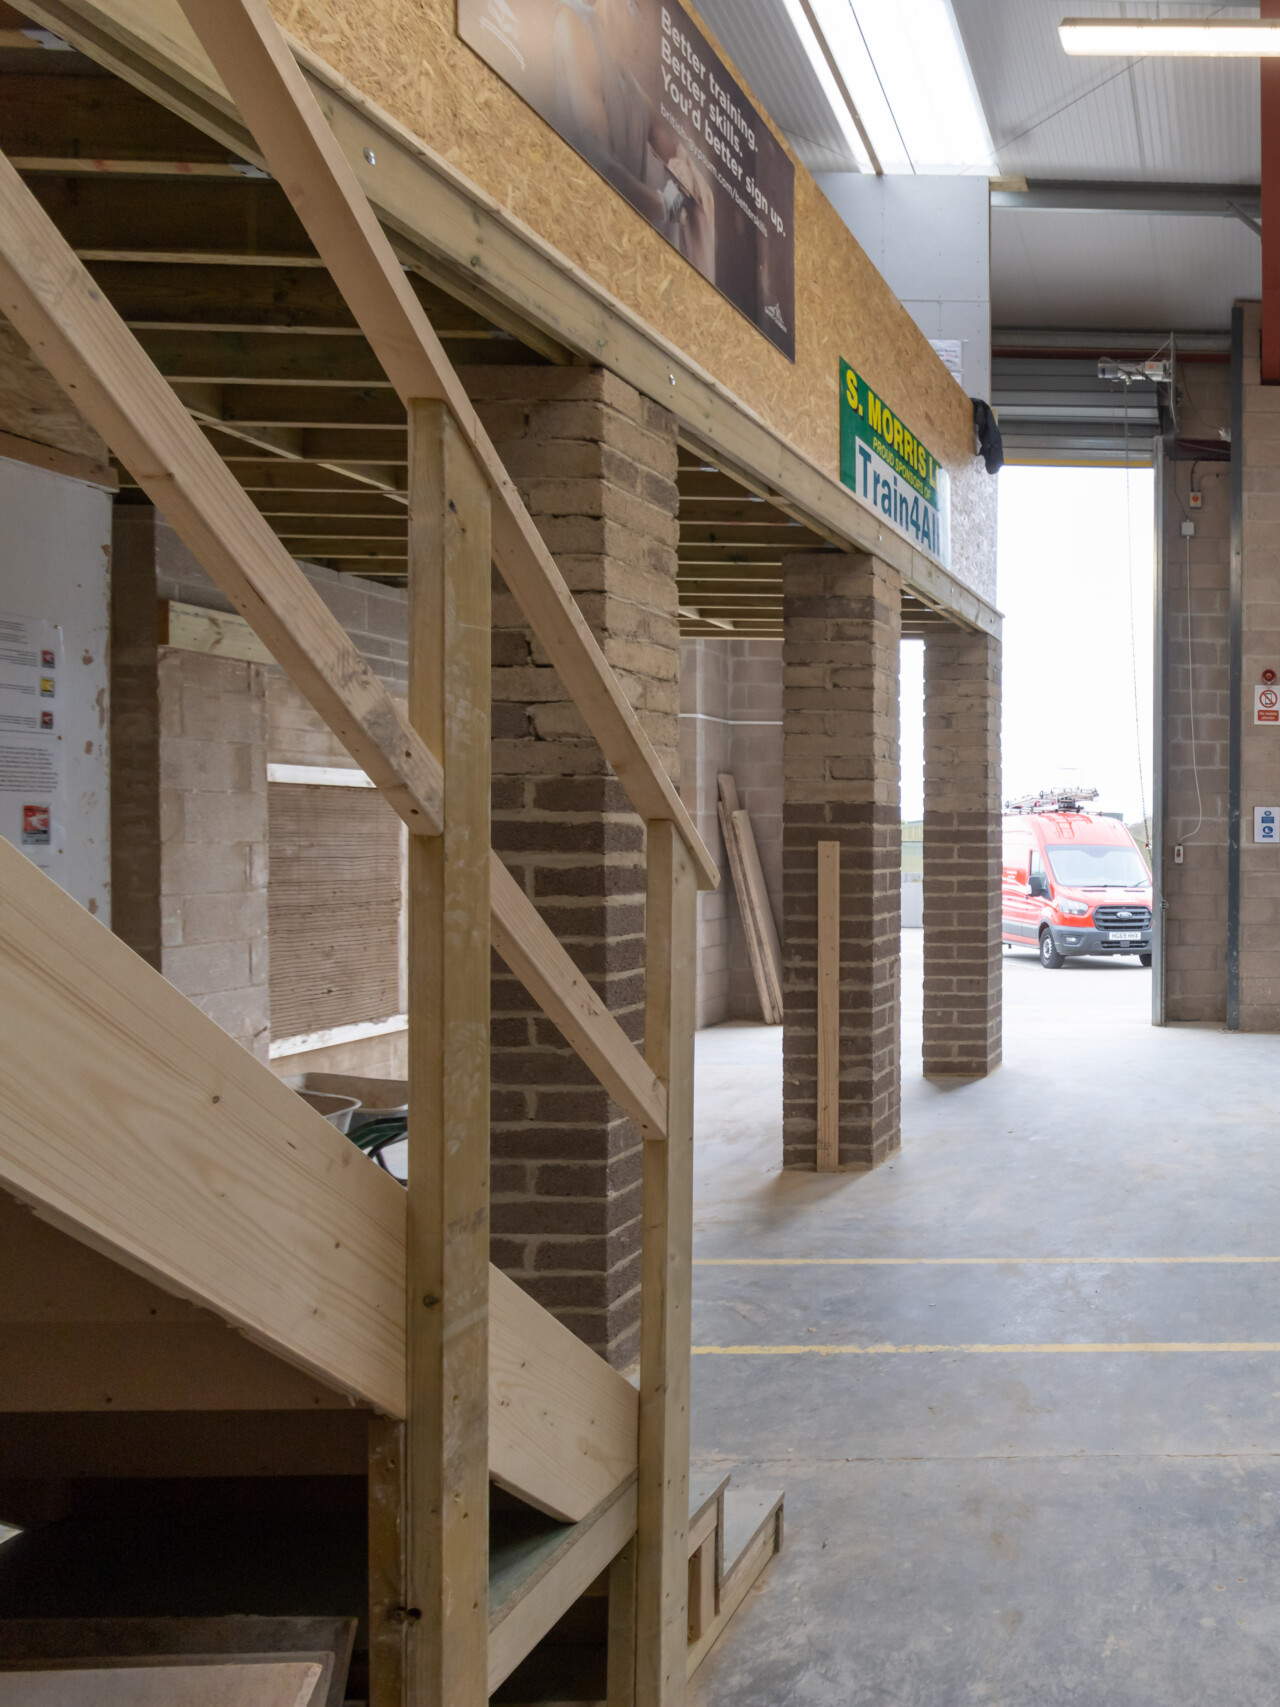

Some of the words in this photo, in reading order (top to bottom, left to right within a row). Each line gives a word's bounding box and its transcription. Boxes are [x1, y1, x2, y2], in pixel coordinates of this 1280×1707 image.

[661, 6, 706, 80] Better
[709, 72, 758, 153] training.
[661, 36, 706, 108] Better
[709, 103, 743, 158] skills.
[661, 64, 701, 132] You'd
[705, 118, 743, 182] better
[746, 175, 768, 215] sign
[770, 207, 786, 238] up.
[846, 369, 864, 417] S.
[867, 391, 927, 480] MORRIS
[872, 437, 895, 467] PROUD
[895, 458, 924, 495] SPONSORS
[923, 487, 932, 500] OF
[858, 445, 941, 558] Train4All
